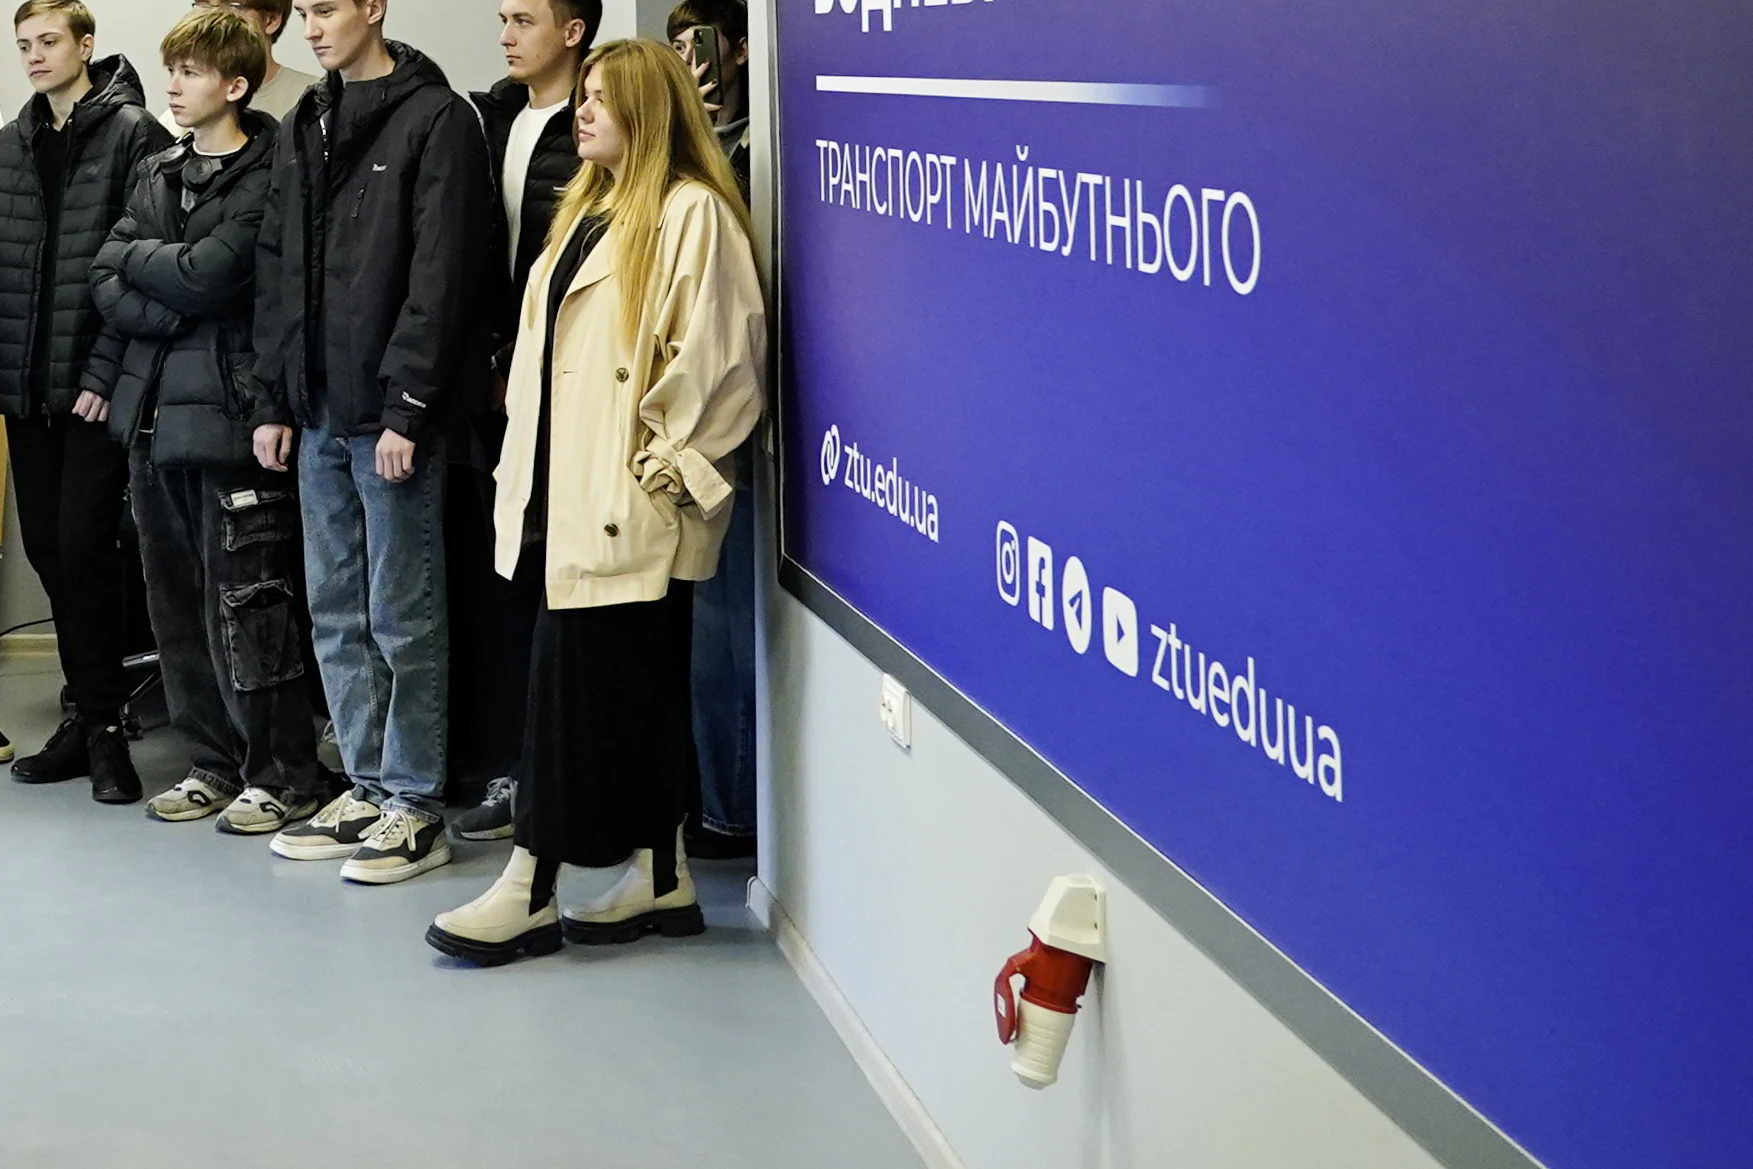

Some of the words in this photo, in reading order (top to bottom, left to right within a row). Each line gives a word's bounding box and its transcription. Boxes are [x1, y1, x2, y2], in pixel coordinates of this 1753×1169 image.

[815, 138, 956, 229] ТРАНСПОРТ
[963, 144, 1262, 296] МАЙБУТНЬОГО
[844, 442, 939, 543] ztu.edu.ua
[1150, 621, 1344, 803] ztueduua
